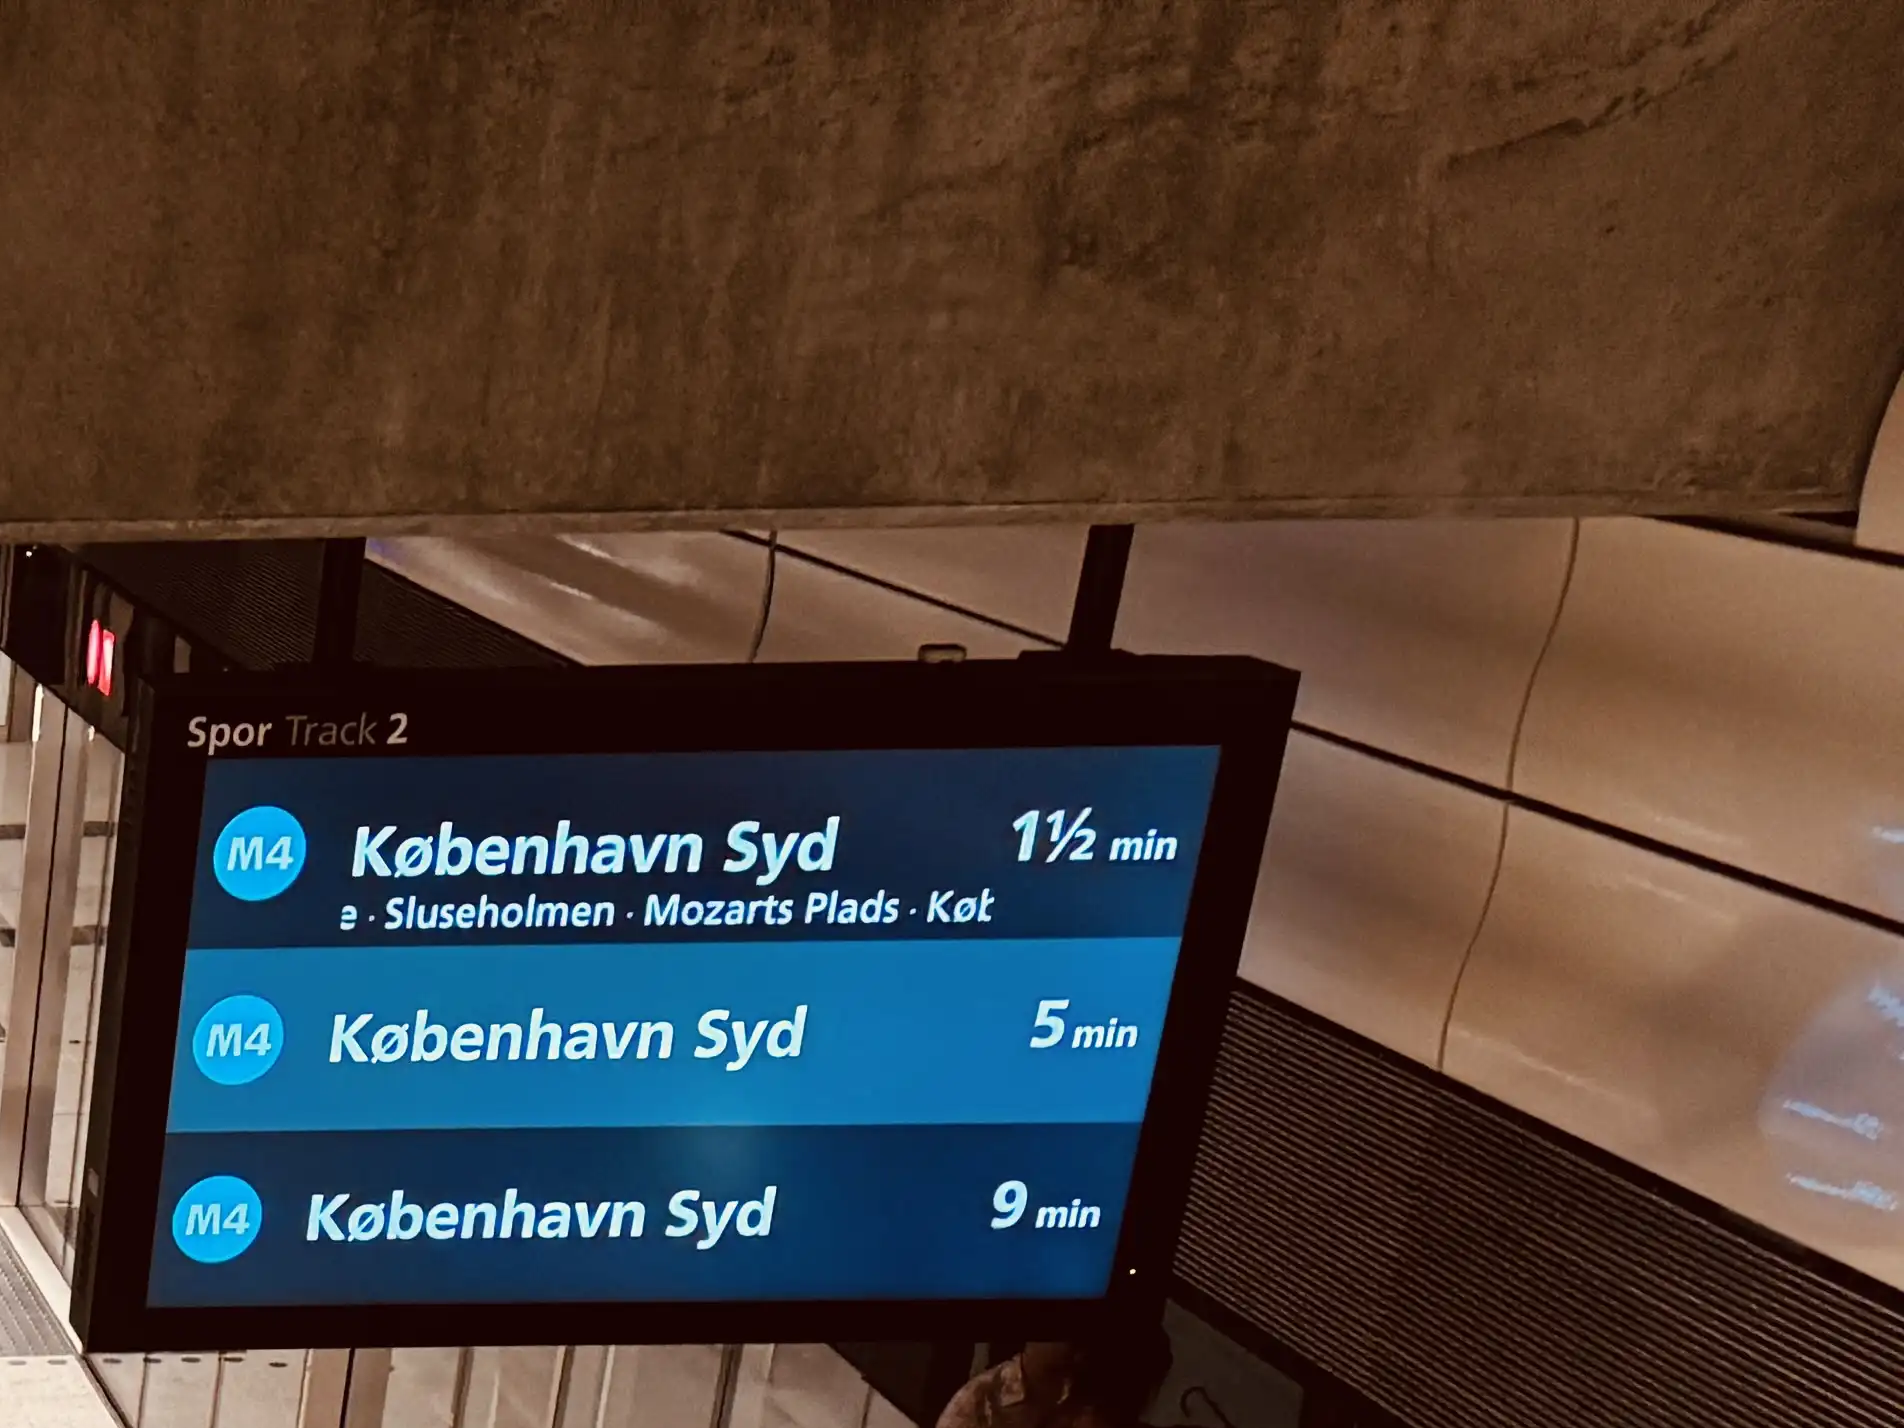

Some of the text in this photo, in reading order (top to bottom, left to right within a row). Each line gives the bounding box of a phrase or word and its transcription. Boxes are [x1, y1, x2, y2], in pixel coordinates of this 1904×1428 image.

[187, 711, 409, 756] Spor Track 2
[226, 834, 295, 873] M4
[350, 818, 704, 879] København
[722, 815, 841, 887] Syd
[1108, 827, 1179, 862] min
[383, 892, 616, 931] Sluseholmen
[643, 893, 794, 927] Mozarts
[804, 888, 900, 925] Plads
[203, 998, 1140, 1073] M4 København Syd 5 min
[183, 1178, 1102, 1251] M4 København Syd 9 min
